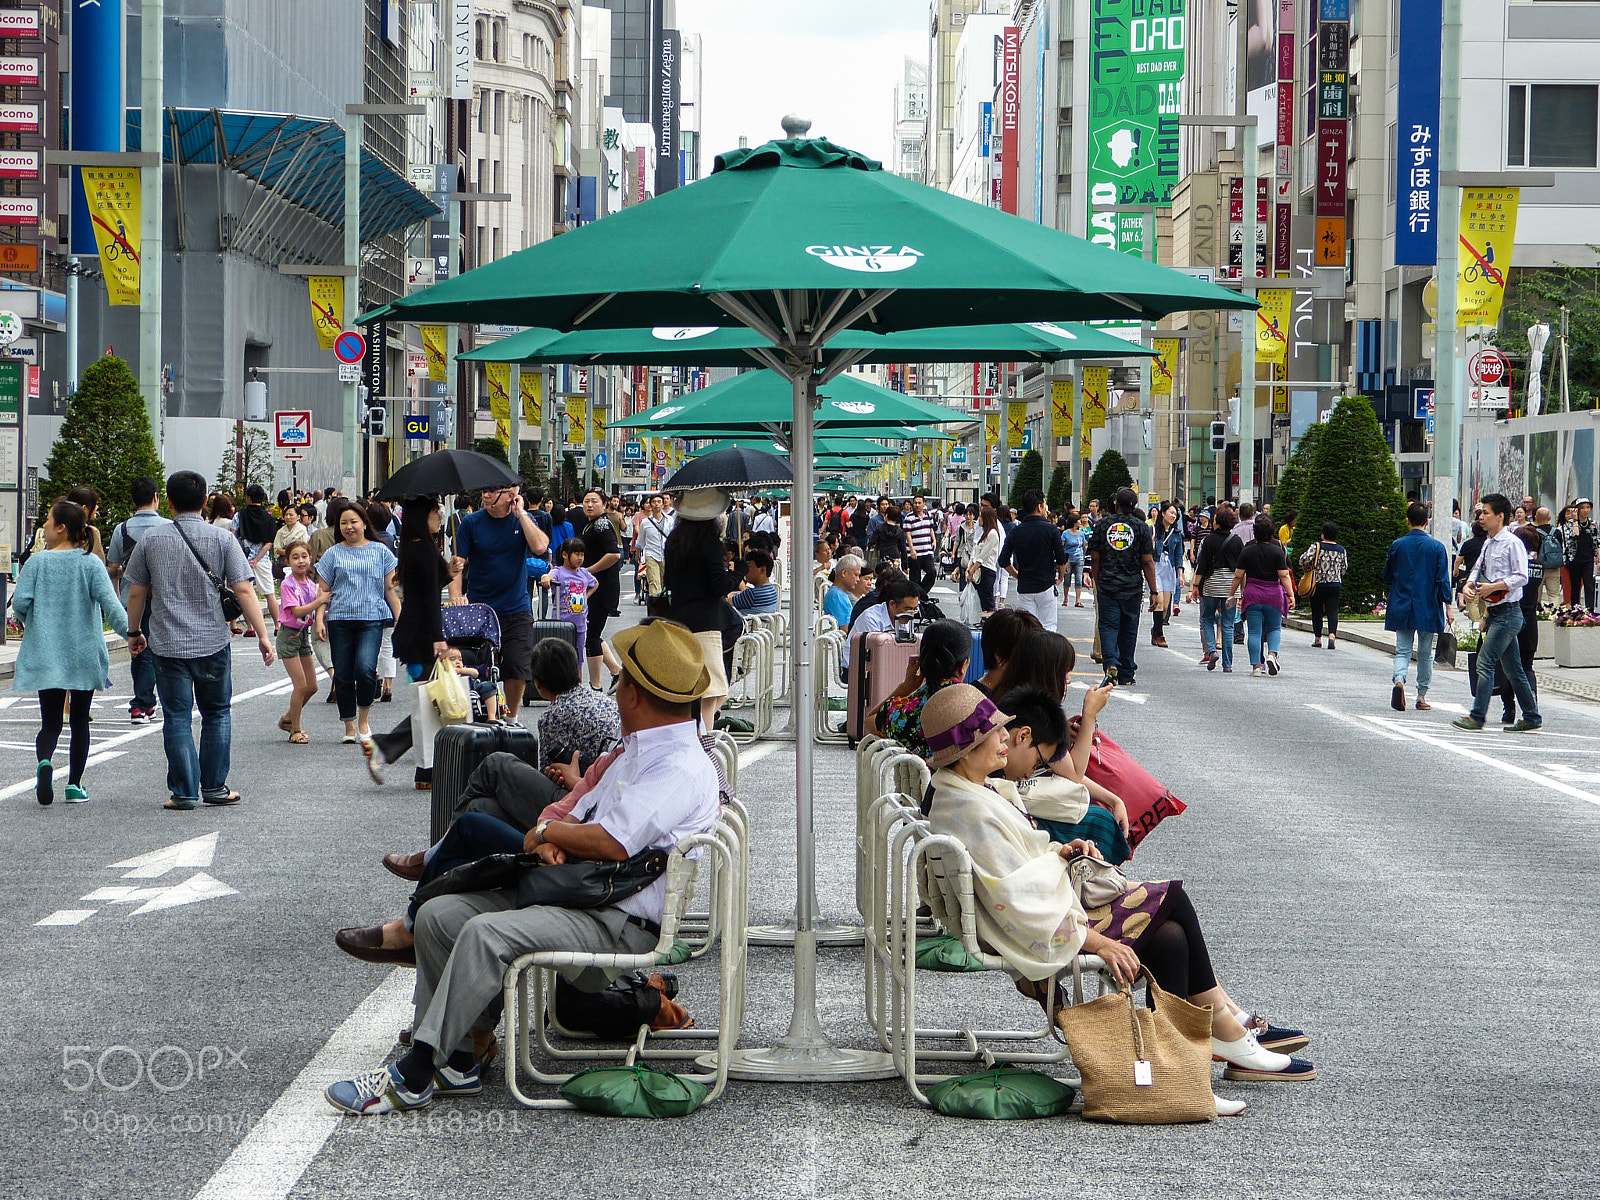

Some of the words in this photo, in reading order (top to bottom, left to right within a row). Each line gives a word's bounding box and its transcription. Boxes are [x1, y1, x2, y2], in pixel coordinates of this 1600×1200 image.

[0, 16, 33, 24] como
[1131, 16, 1184, 52] DAD
[455, 4, 470, 88] TASAKI
[662, 38, 675, 78] Zegna
[0, 63, 33, 71] como
[1005, 33, 1017, 130] MITSUKOSHI
[1137, 63, 1149, 73] BEST
[1151, 62, 1163, 72] DAD
[1163, 61, 1177, 71] EVER
[0, 110, 33, 118] como
[1093, 85, 1157, 118] DAD
[1322, 85, 1343, 116] 歯科
[660, 79, 674, 158] Ermenegildo
[0, 157, 33, 165] como
[1324, 138, 1339, 197] ナカヤ
[1409, 124, 1432, 233] みずほ銀行
[0, 204, 33, 212] como
[1470, 212, 1506, 220] 押し歩き
[805, 245, 925, 257] GINZA
[1121, 231, 1134, 242] DAY
[1193, 204, 1214, 267] GINZ
[1279, 207, 1287, 265] ワタベウェディング
[865, 257, 882, 270] 6
[1192, 311, 1212, 364] ORE
[372, 322, 381, 394] WASHINGTON
[407, 421, 429, 433] GU
